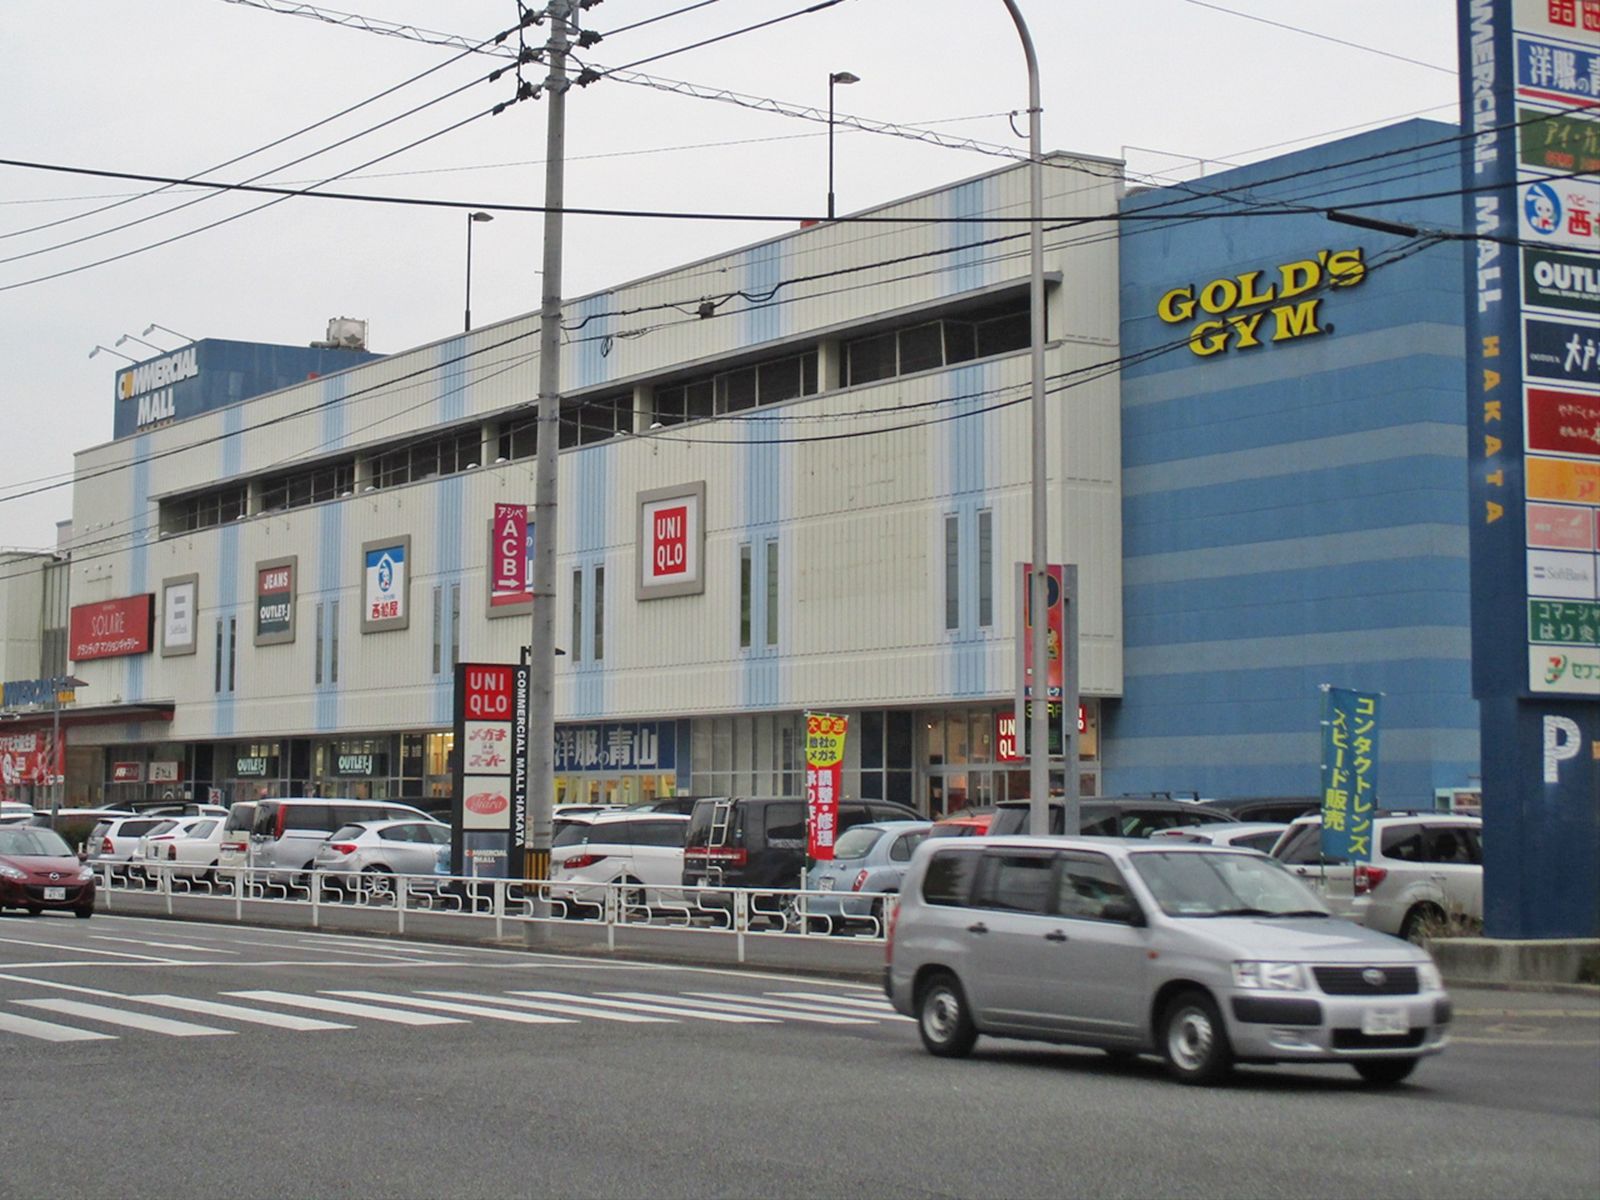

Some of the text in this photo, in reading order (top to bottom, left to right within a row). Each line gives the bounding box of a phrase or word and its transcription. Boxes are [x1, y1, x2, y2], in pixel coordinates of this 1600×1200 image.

[1471, 0, 1505, 524] MERCIAL MALL HAKATA
[1157, 247, 1366, 324] GOLD'S
[1533, 261, 1600, 293] OUTL
[1188, 298, 1321, 357] GYM
[1564, 333, 1600, 372] 大戸
[118, 348, 198, 400] COMMERCIAL
[137, 386, 175, 426] MALL
[498, 506, 524, 519] アシベ
[656, 516, 682, 541] UNI
[656, 543, 684, 571] QLO
[264, 571, 289, 590] JEANS
[260, 603, 291, 625] OUTLET-J
[372, 600, 399, 620] 西松屋
[91, 611, 125, 637] SOLARE
[470, 672, 505, 690] UNI
[470, 694, 508, 716] QLO
[468, 727, 507, 742] メガネ
[999, 719, 1015, 736] UN
[515, 670, 527, 848] COMMERCIAL MALL HAKATA
[554, 727, 658, 768] 洋服の青山
[809, 750, 837, 761] メガネ
[999, 739, 1015, 758] QL
[1543, 714, 1582, 784] P
[236, 757, 267, 776] OUTLET-J
[338, 754, 373, 775] OUTLET-J
[468, 754, 506, 768] スーパー
[1347, 697, 1375, 856] コンタクトレンズ
